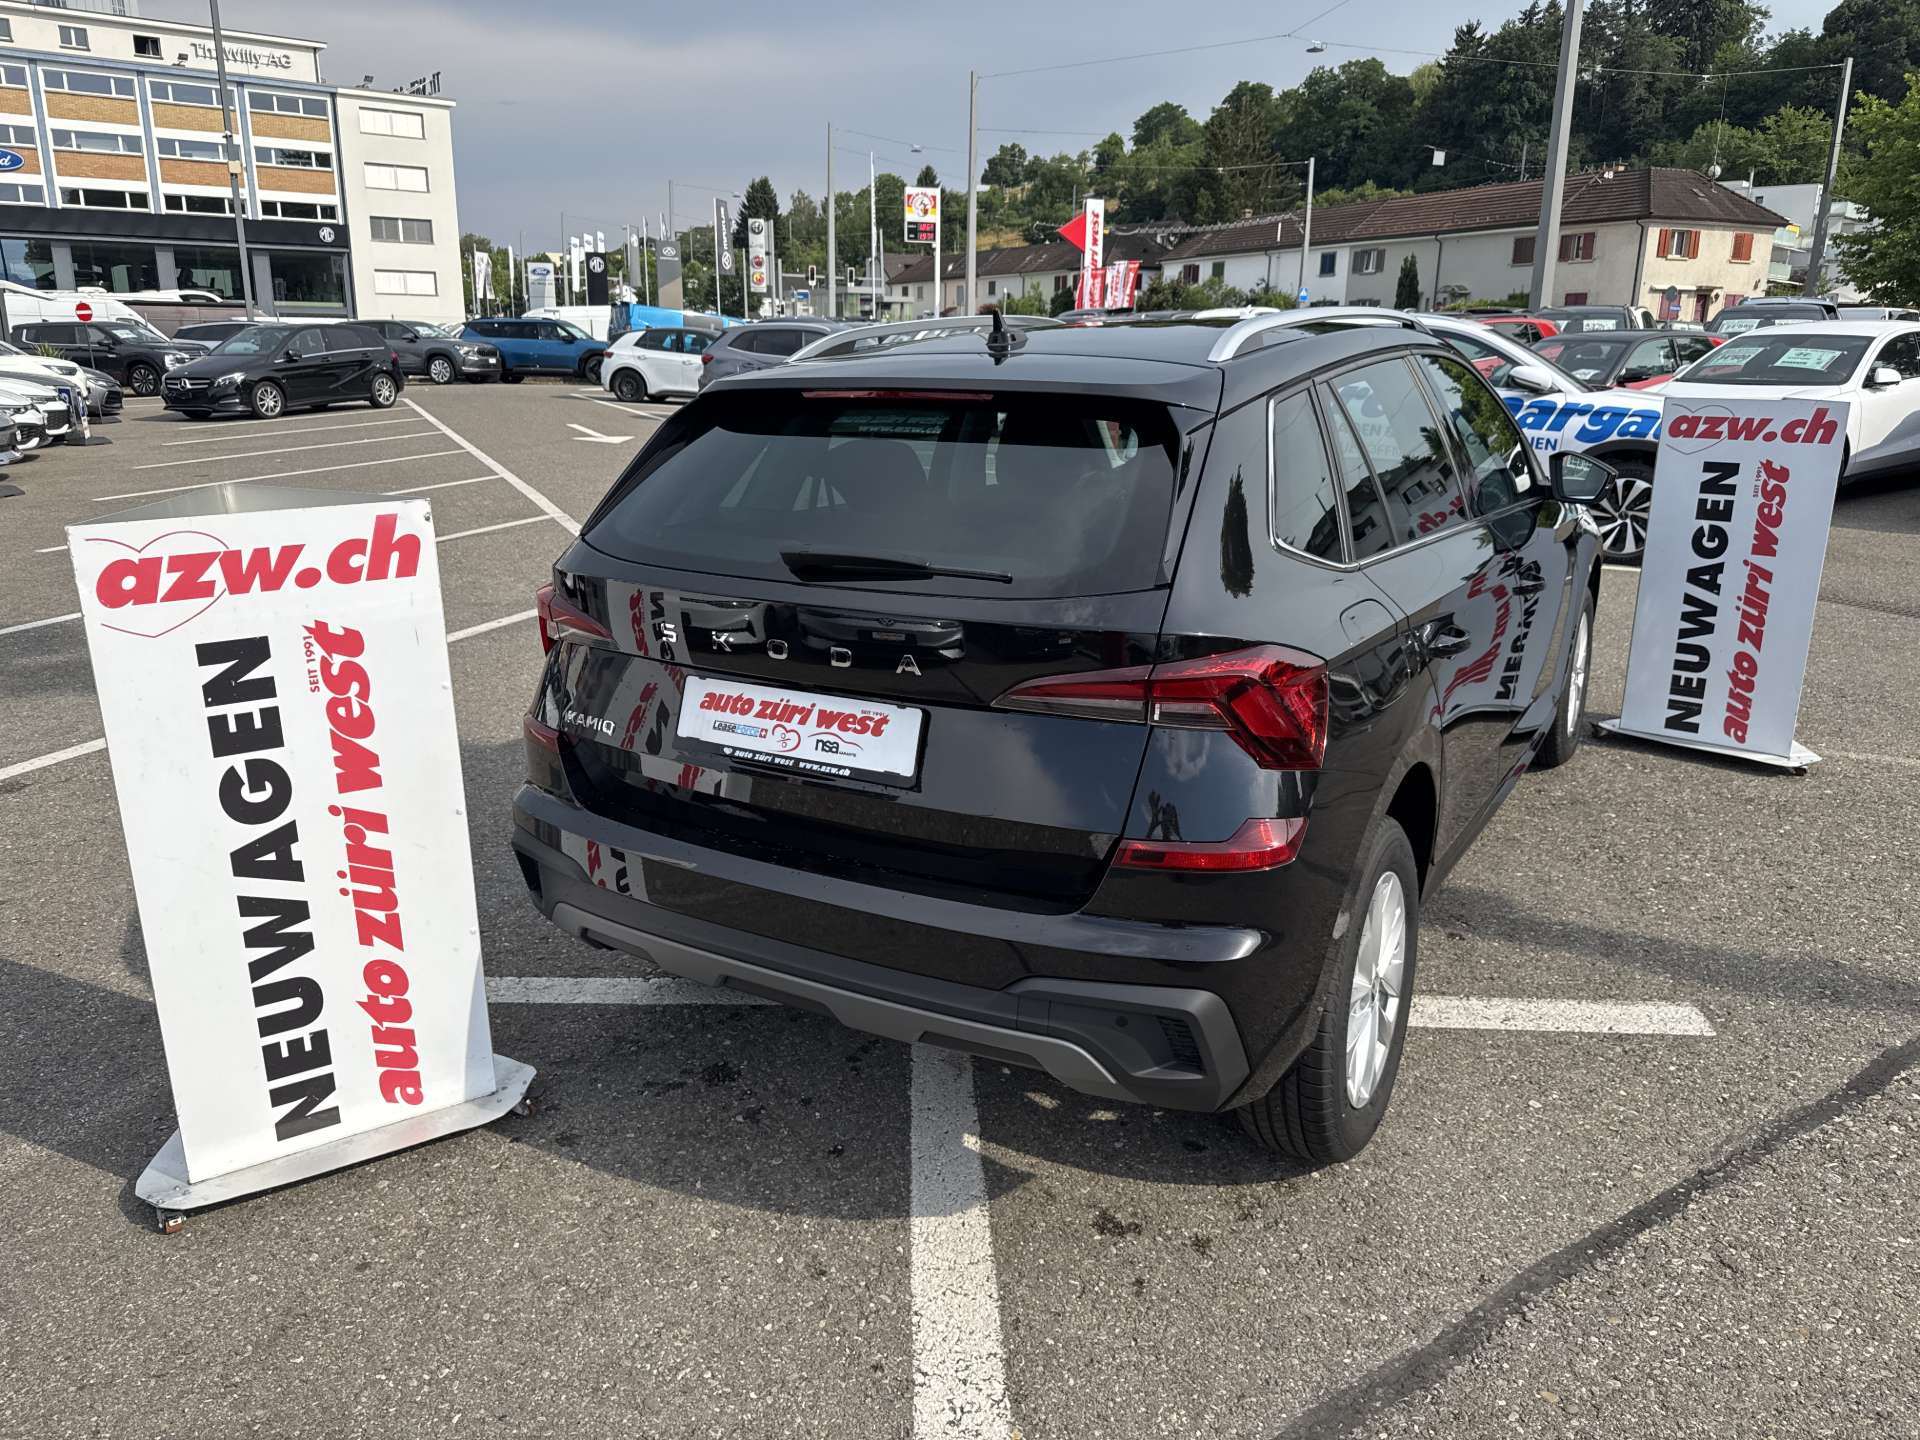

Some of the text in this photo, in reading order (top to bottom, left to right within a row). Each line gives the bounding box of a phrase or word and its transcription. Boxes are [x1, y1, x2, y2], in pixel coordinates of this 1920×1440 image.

[264, 52, 292, 69] AG
[1531, 436, 1558, 451] IEN
[1668, 408, 1838, 445] azw.ch
[96, 513, 421, 609] azw.ch
[1664, 461, 1741, 734] NEUWAGEN
[1723, 459, 1791, 744] auto züri west
[303, 635, 321, 693] SEIT 1991
[566, 709, 616, 737] KAMIQ
[700, 692, 890, 737] auto züri west
[734, 750, 851, 777] auto züri west www.azw.ch
[815, 739, 840, 754] nsa
[302, 619, 424, 1105] auto züri west
[195, 635, 342, 1142] NEUWAGEN
